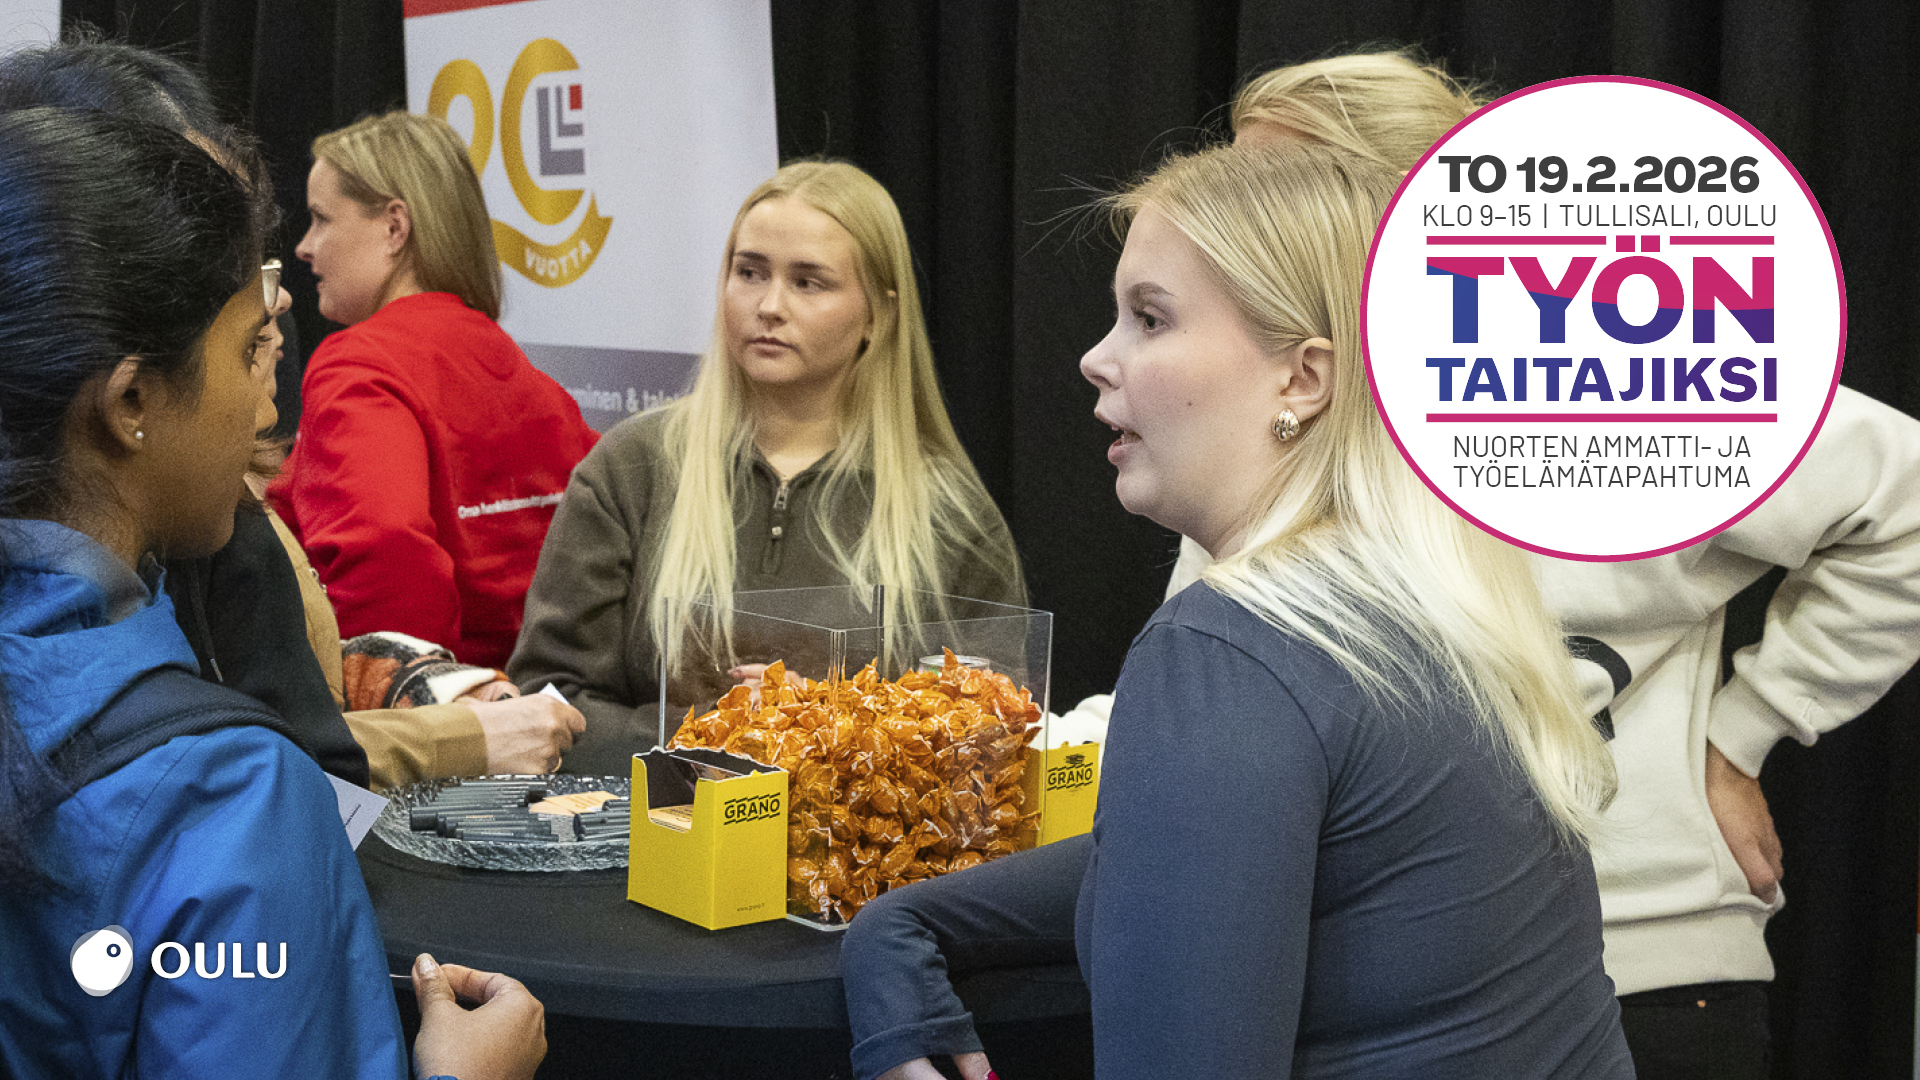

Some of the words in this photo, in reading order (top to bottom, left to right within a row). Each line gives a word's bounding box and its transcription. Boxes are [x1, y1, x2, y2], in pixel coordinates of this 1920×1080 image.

[525, 239, 592, 280] VUOTTA
[1048, 767, 1093, 785] GRANO
[725, 798, 780, 819] GRANO
